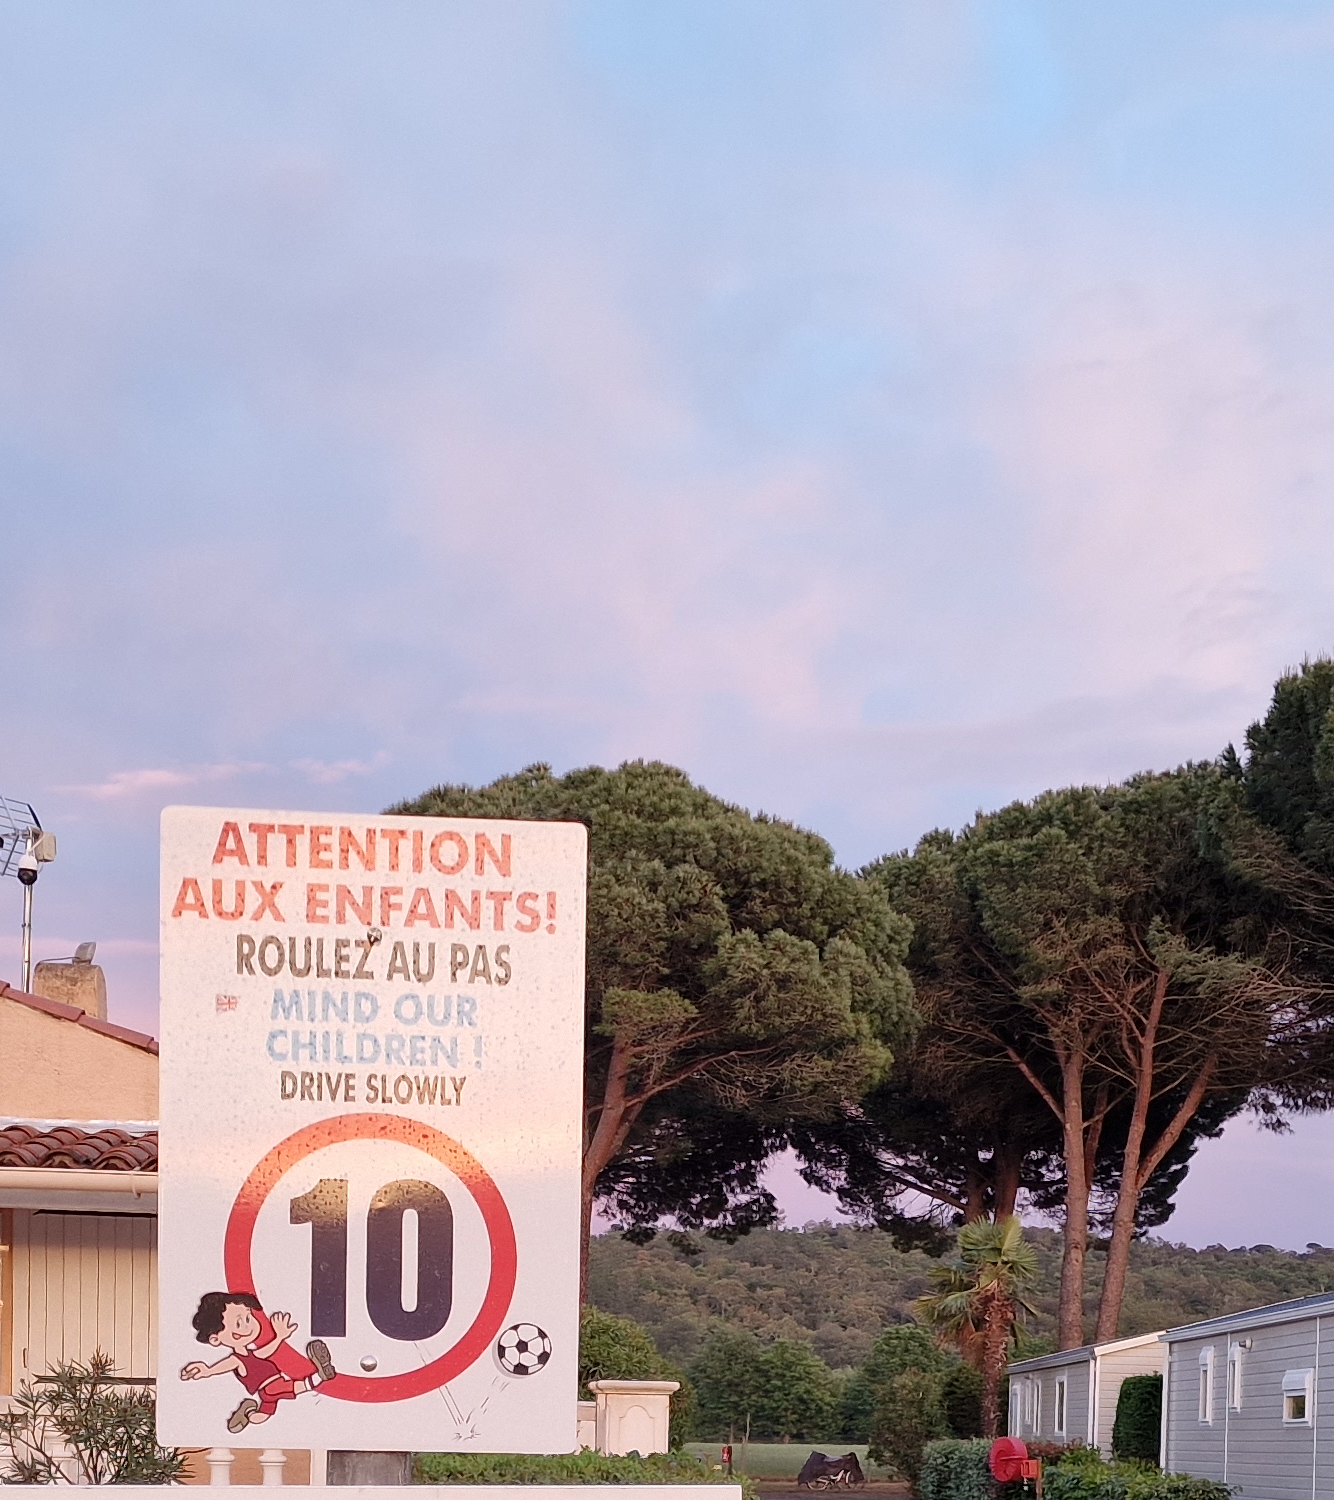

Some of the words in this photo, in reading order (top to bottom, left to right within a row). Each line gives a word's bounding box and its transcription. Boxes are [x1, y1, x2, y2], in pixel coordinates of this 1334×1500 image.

[211, 821, 512, 877] ATTENTION
[172, 877, 285, 922] AUX
[306, 883, 557, 935] ENFANTS!
[237, 934, 376, 980] ROULEZ
[386, 942, 436, 982] AU
[450, 942, 512, 986] PAS
[270, 989, 378, 1025] MIND
[393, 994, 479, 1027] OUR
[266, 1029, 460, 1068] CHILDREN
[281, 1071, 357, 1104] DRIVE
[365, 1073, 466, 1107] SLOWLY
[289, 1178, 454, 1341] 10
